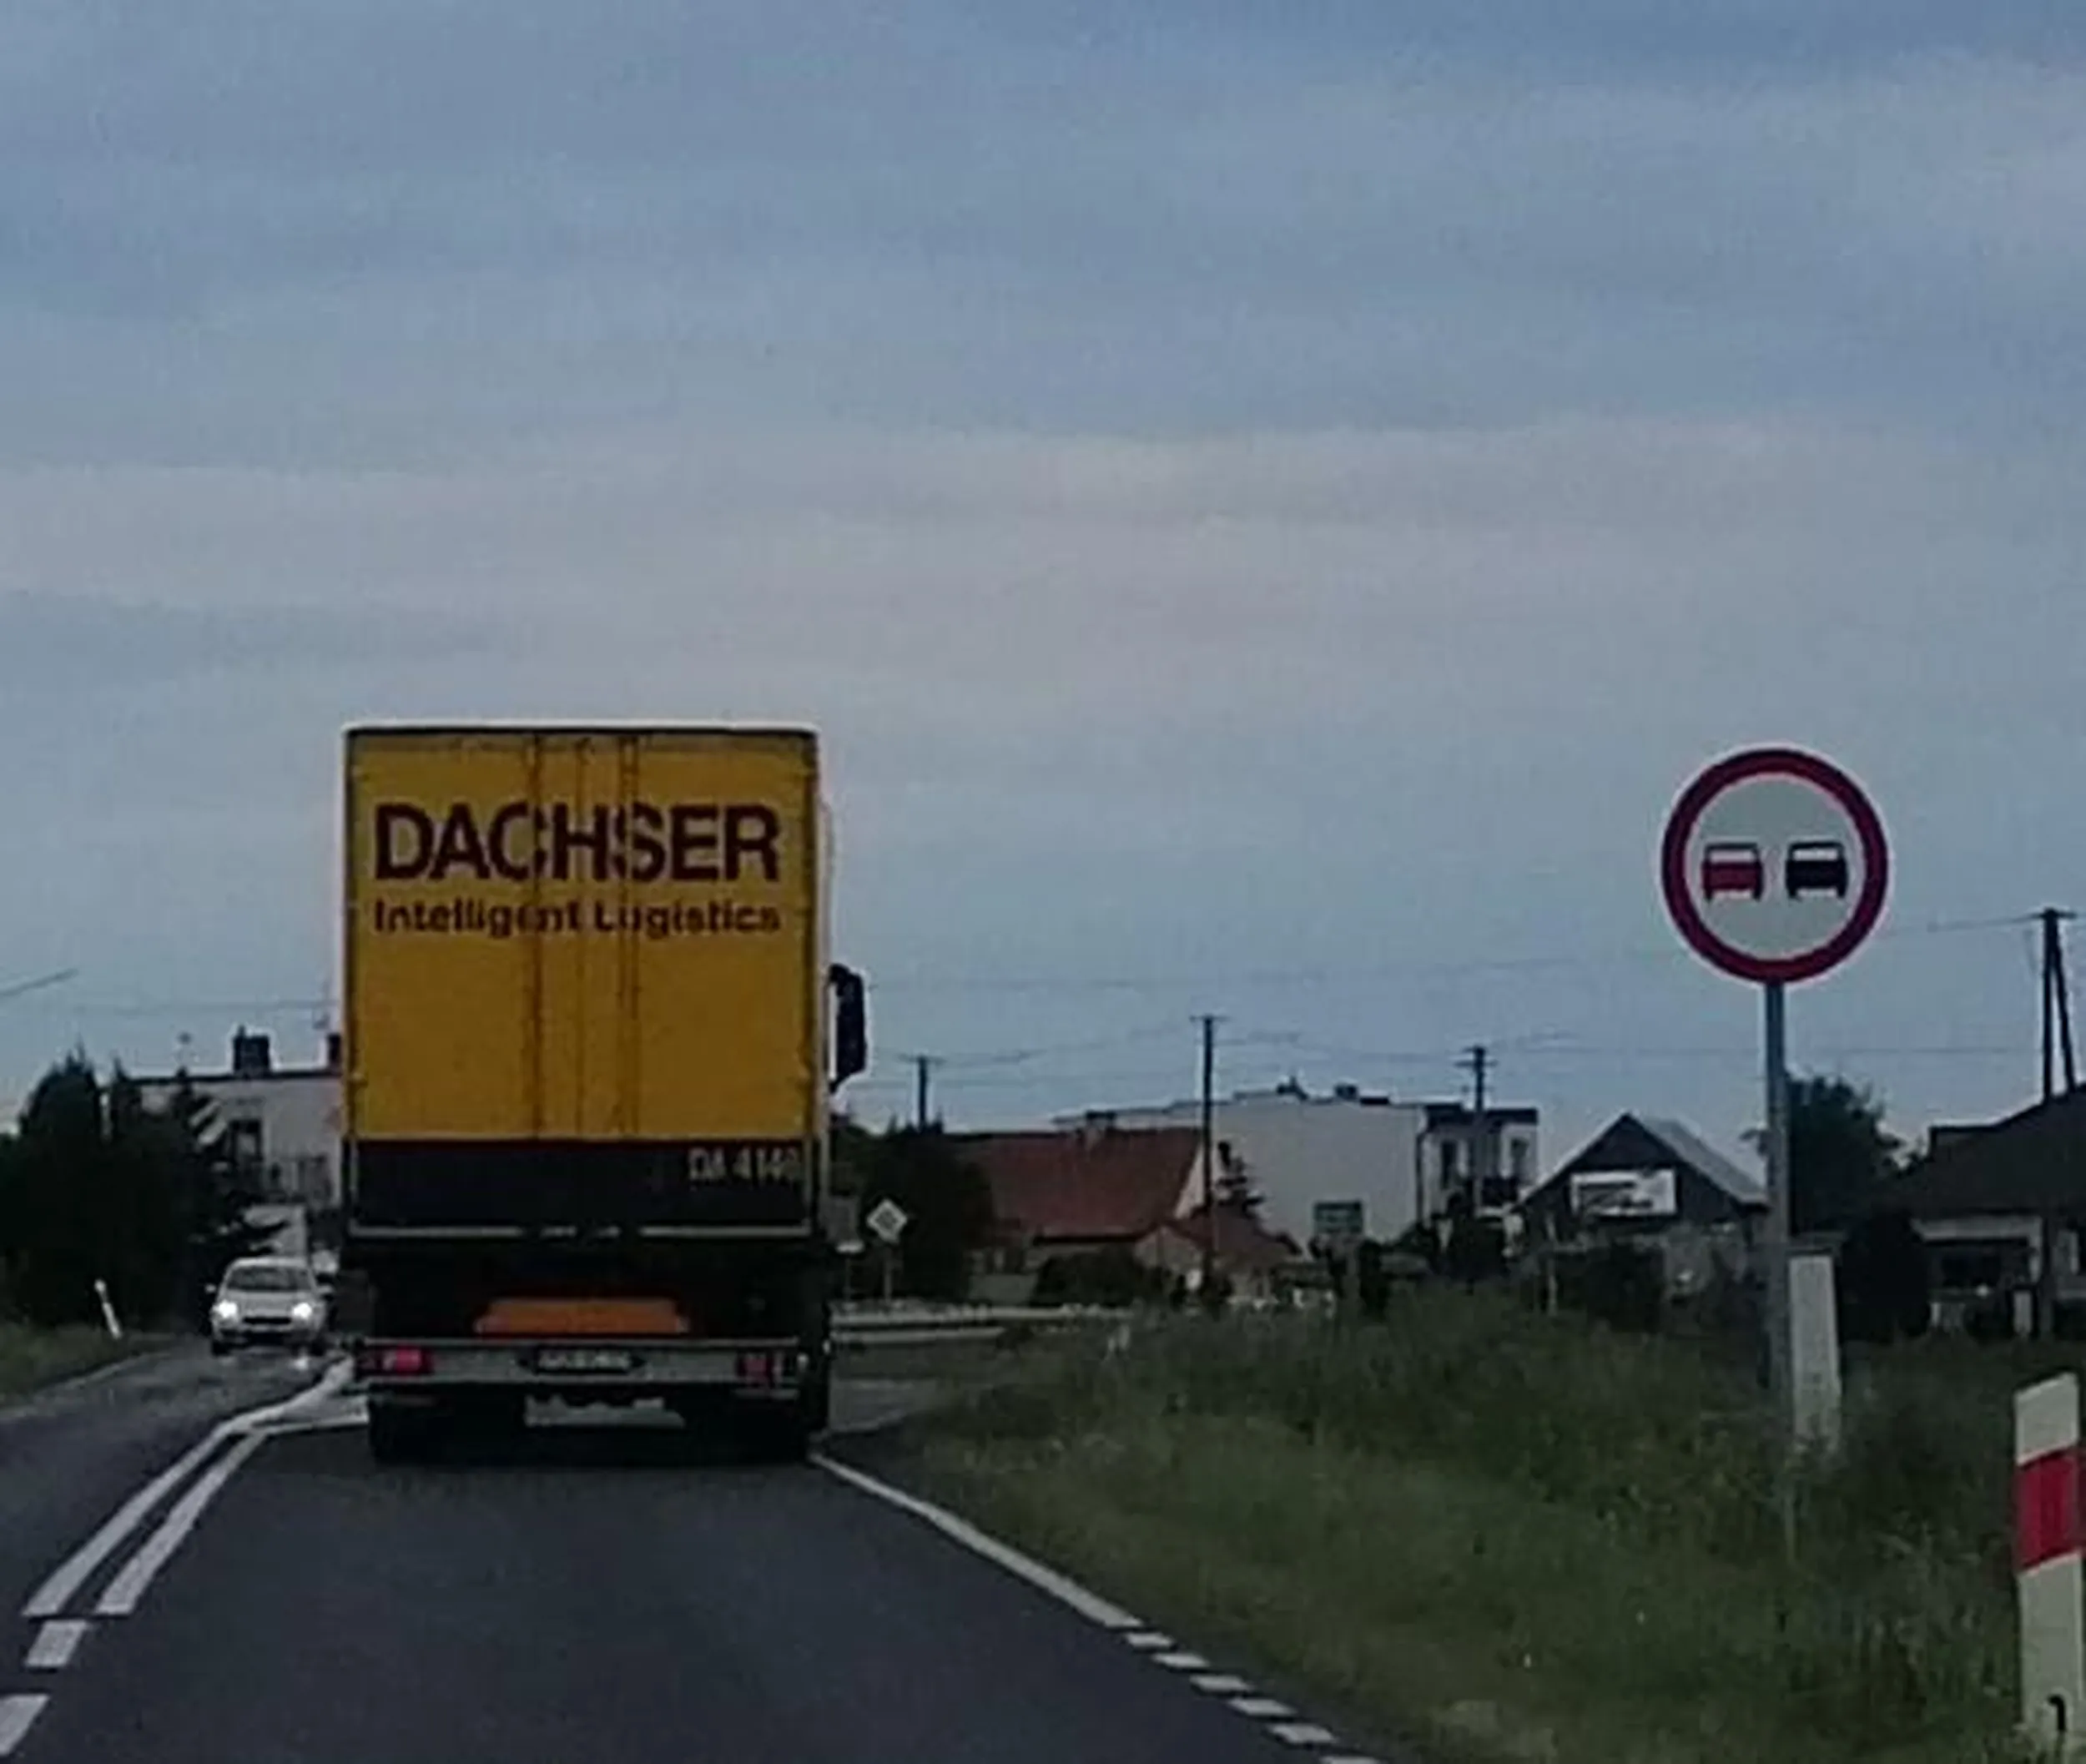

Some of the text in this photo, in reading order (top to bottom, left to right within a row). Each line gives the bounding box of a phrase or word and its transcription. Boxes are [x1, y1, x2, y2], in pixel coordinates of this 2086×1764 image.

[373, 802, 781, 882] DACHSER
[373, 898, 781, 939] Intelligent Logistics
